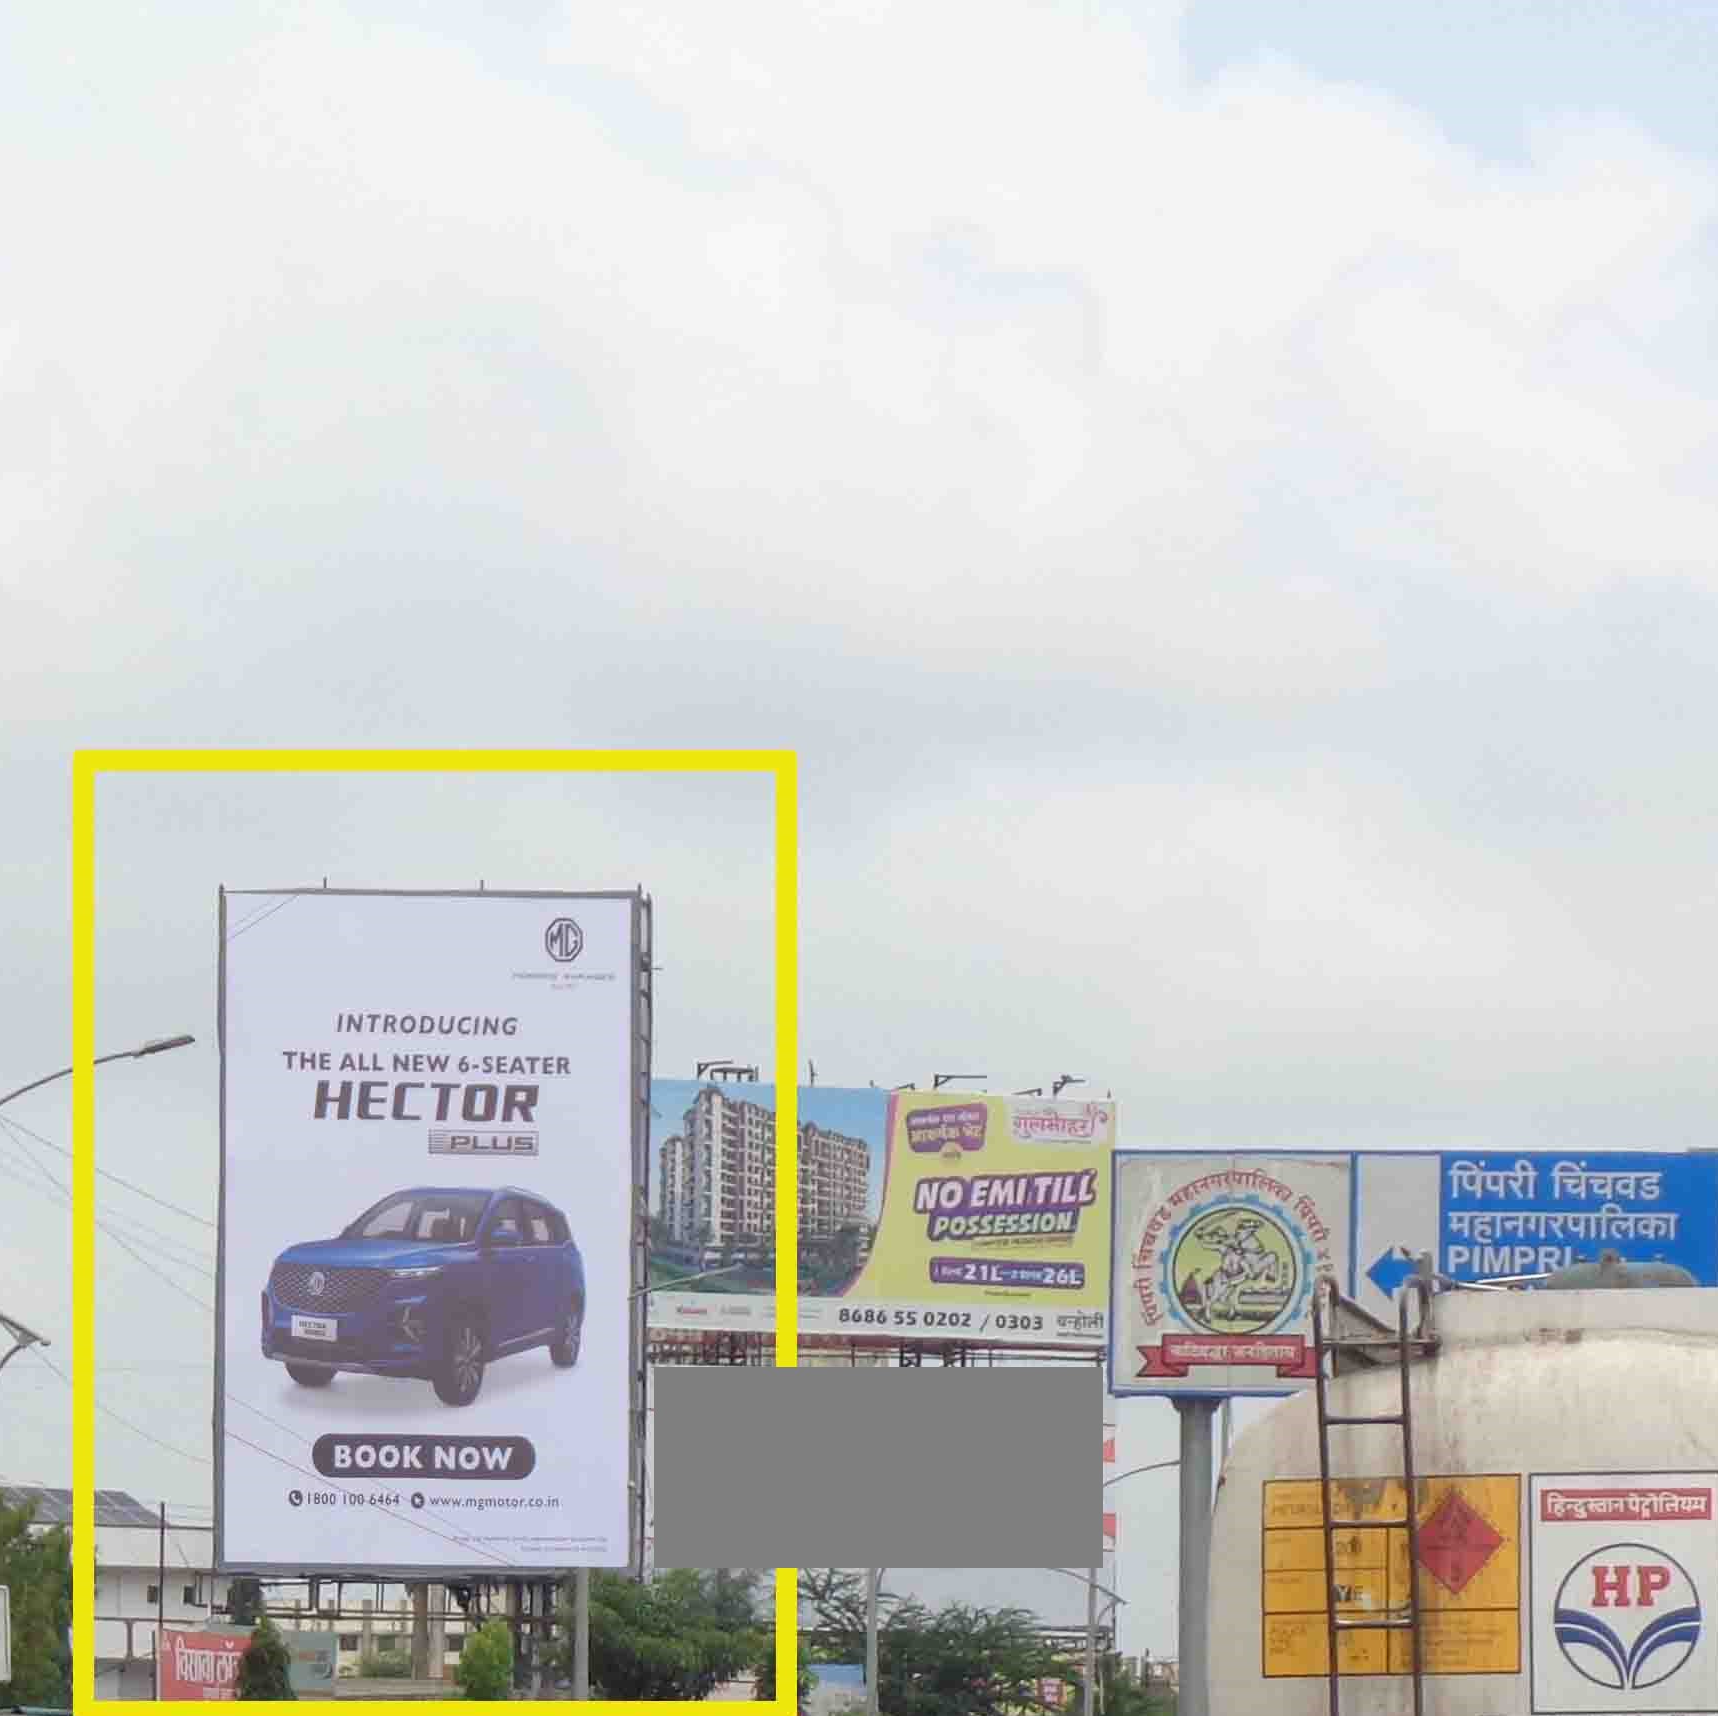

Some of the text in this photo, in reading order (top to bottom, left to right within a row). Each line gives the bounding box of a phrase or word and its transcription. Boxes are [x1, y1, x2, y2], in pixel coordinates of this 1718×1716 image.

[336, 1012, 519, 1037] INTRODUCING
[282, 1050, 572, 1075] THE ALL NEW 6-SEATER
[313, 1079, 540, 1122] HECTOR
[450, 1134, 535, 1152] PLUS
[915, 1172, 1094, 1211] NO EMI TILL
[1447, 1160, 1663, 1200] पिंपरी चिंचवड
[933, 1210, 1074, 1237] POSSESSION
[1447, 1203, 1680, 1243] महानगरपालिका
[1447, 1246, 1572, 1274] PIMPRI
[963, 1263, 1004, 1282] 21L
[1043, 1267, 1083, 1286] 26L
[838, 1306, 888, 1325] 8686
[893, 1311, 917, 1327] 55
[923, 1311, 972, 1328] 0202
[994, 1314, 1044, 1331] 0303
[333, 1444, 513, 1471] BOOK NOW
[307, 1491, 560, 1510] 1800 100 6464 www.mgmotor.co.in
[1591, 1565, 1671, 1608] HP
